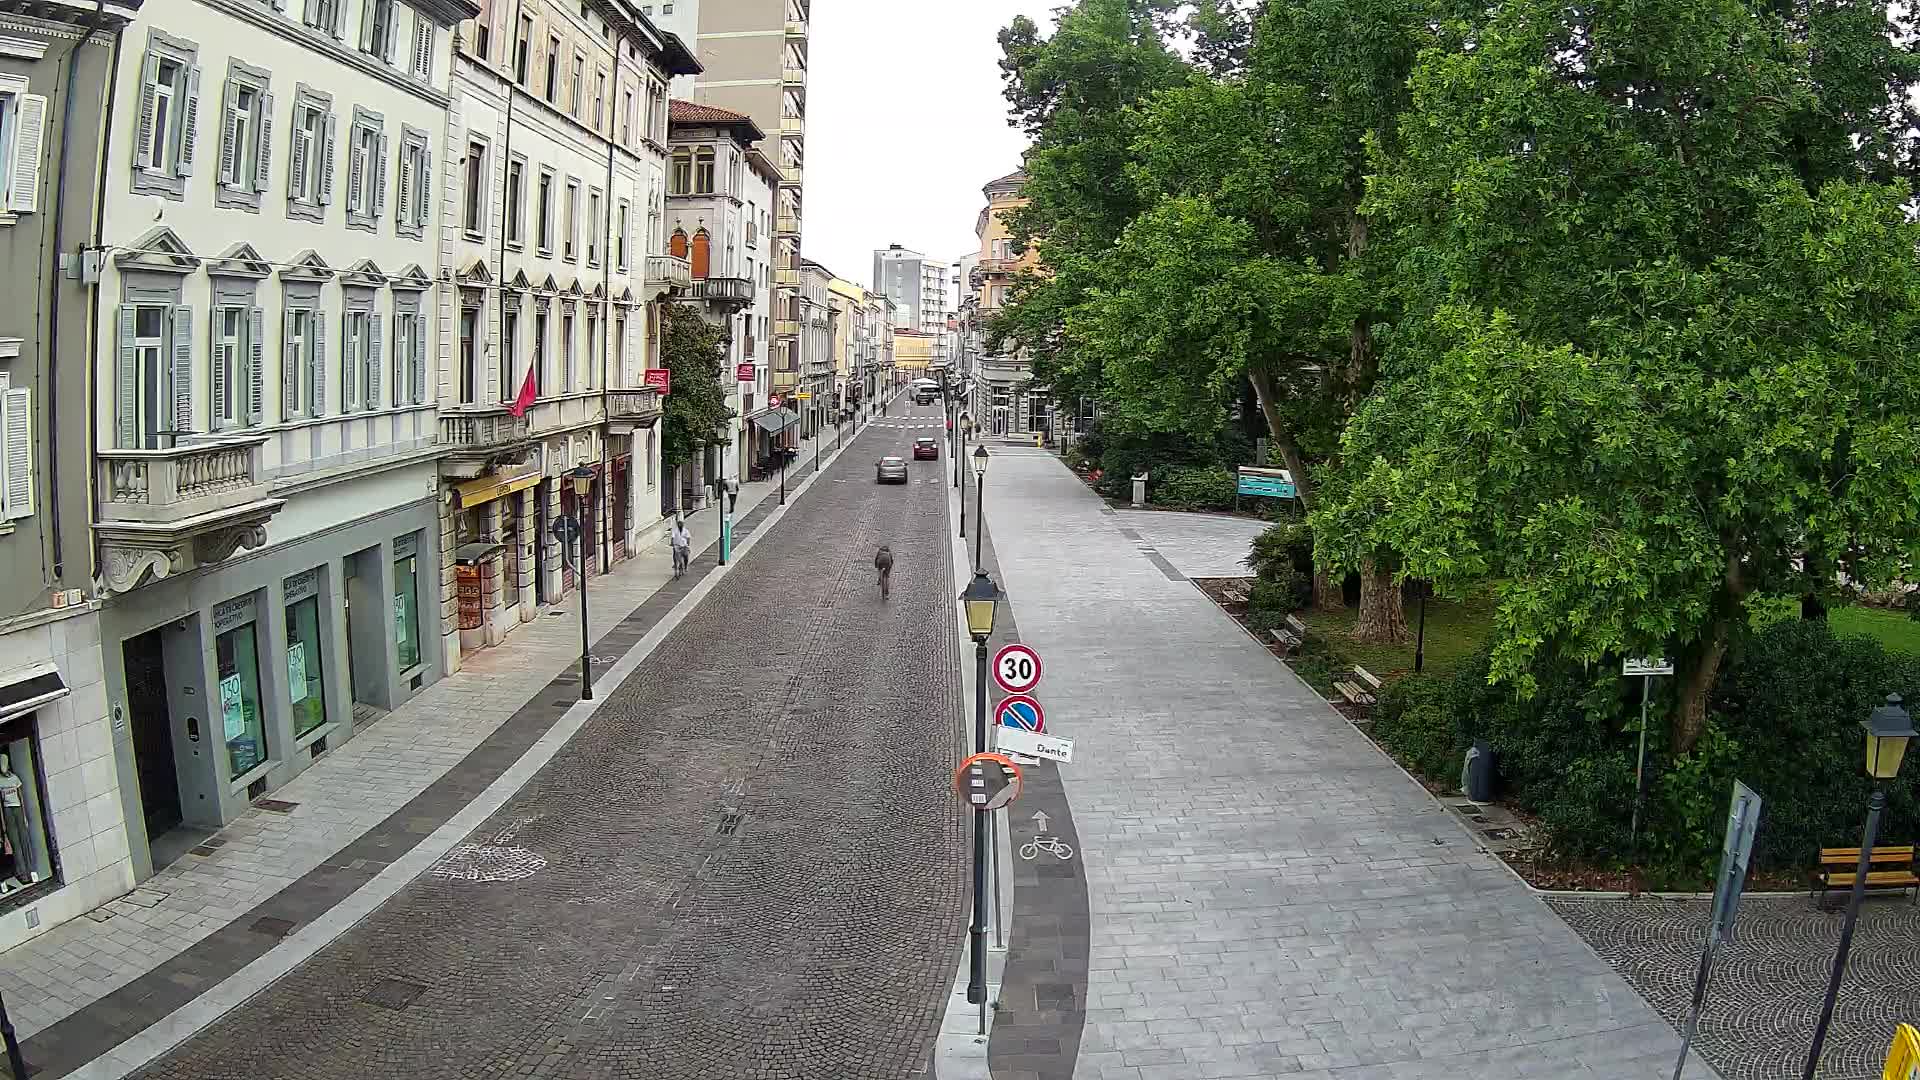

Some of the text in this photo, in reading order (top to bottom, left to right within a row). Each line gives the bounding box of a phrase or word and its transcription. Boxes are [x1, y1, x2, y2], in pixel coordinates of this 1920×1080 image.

[1005, 658, 1031, 680] 30
[221, 677, 239, 700] 130
[1037, 744, 1067, 757] Dante
